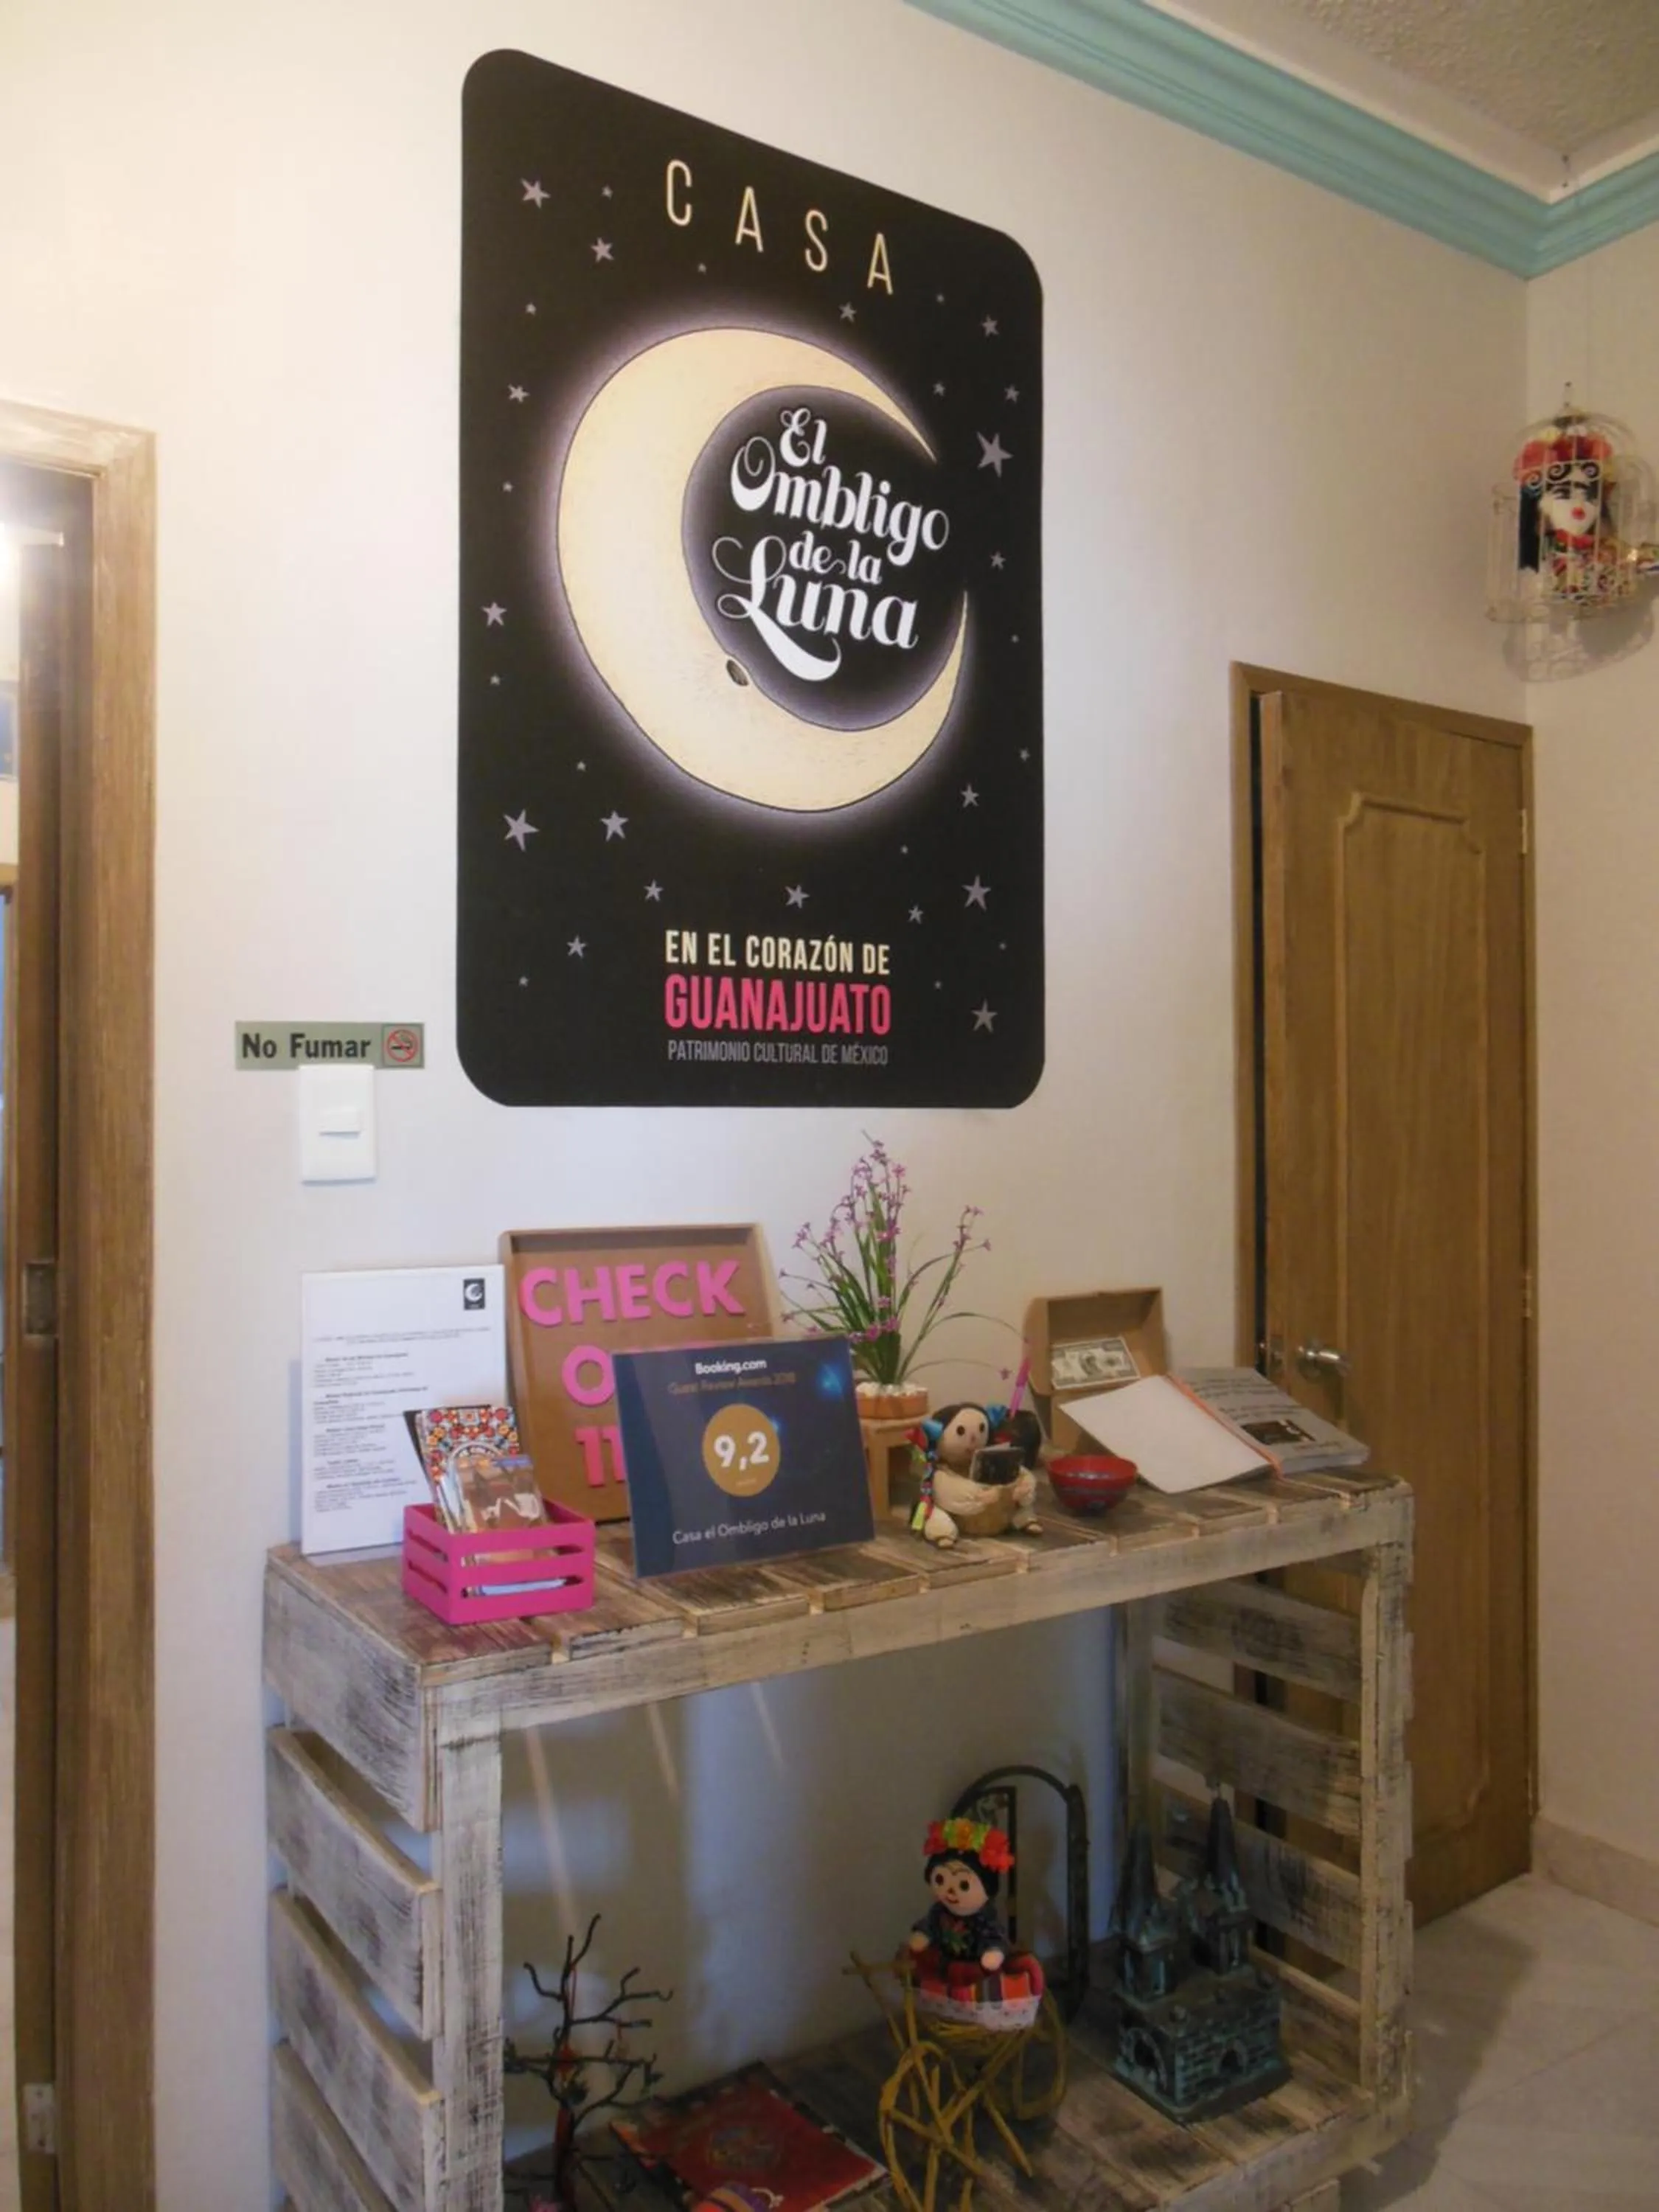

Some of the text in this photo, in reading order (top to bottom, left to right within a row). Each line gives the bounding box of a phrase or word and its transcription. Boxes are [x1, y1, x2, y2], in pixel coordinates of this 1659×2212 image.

[665, 159, 894, 295] CASA
[779, 407, 827, 467] El
[730, 436, 950, 566] Ombligo
[788, 529, 883, 585] de la
[712, 535, 919, 681] Luna
[665, 930, 891, 975] EN EL CORAZÓN DE
[665, 973, 891, 1036] GUANAJUATO
[242, 1033, 371, 1059] No Fumar
[667, 1040, 888, 1065] PATRIMONIO CULTURAL DE MÉXICO
[520, 1260, 745, 1327] CHECK
[695, 1360, 768, 1374] Booking.com
[713, 1430, 770, 1471] 9,2
[672, 1512, 827, 1545] Casa el Ombligo de la Luna
